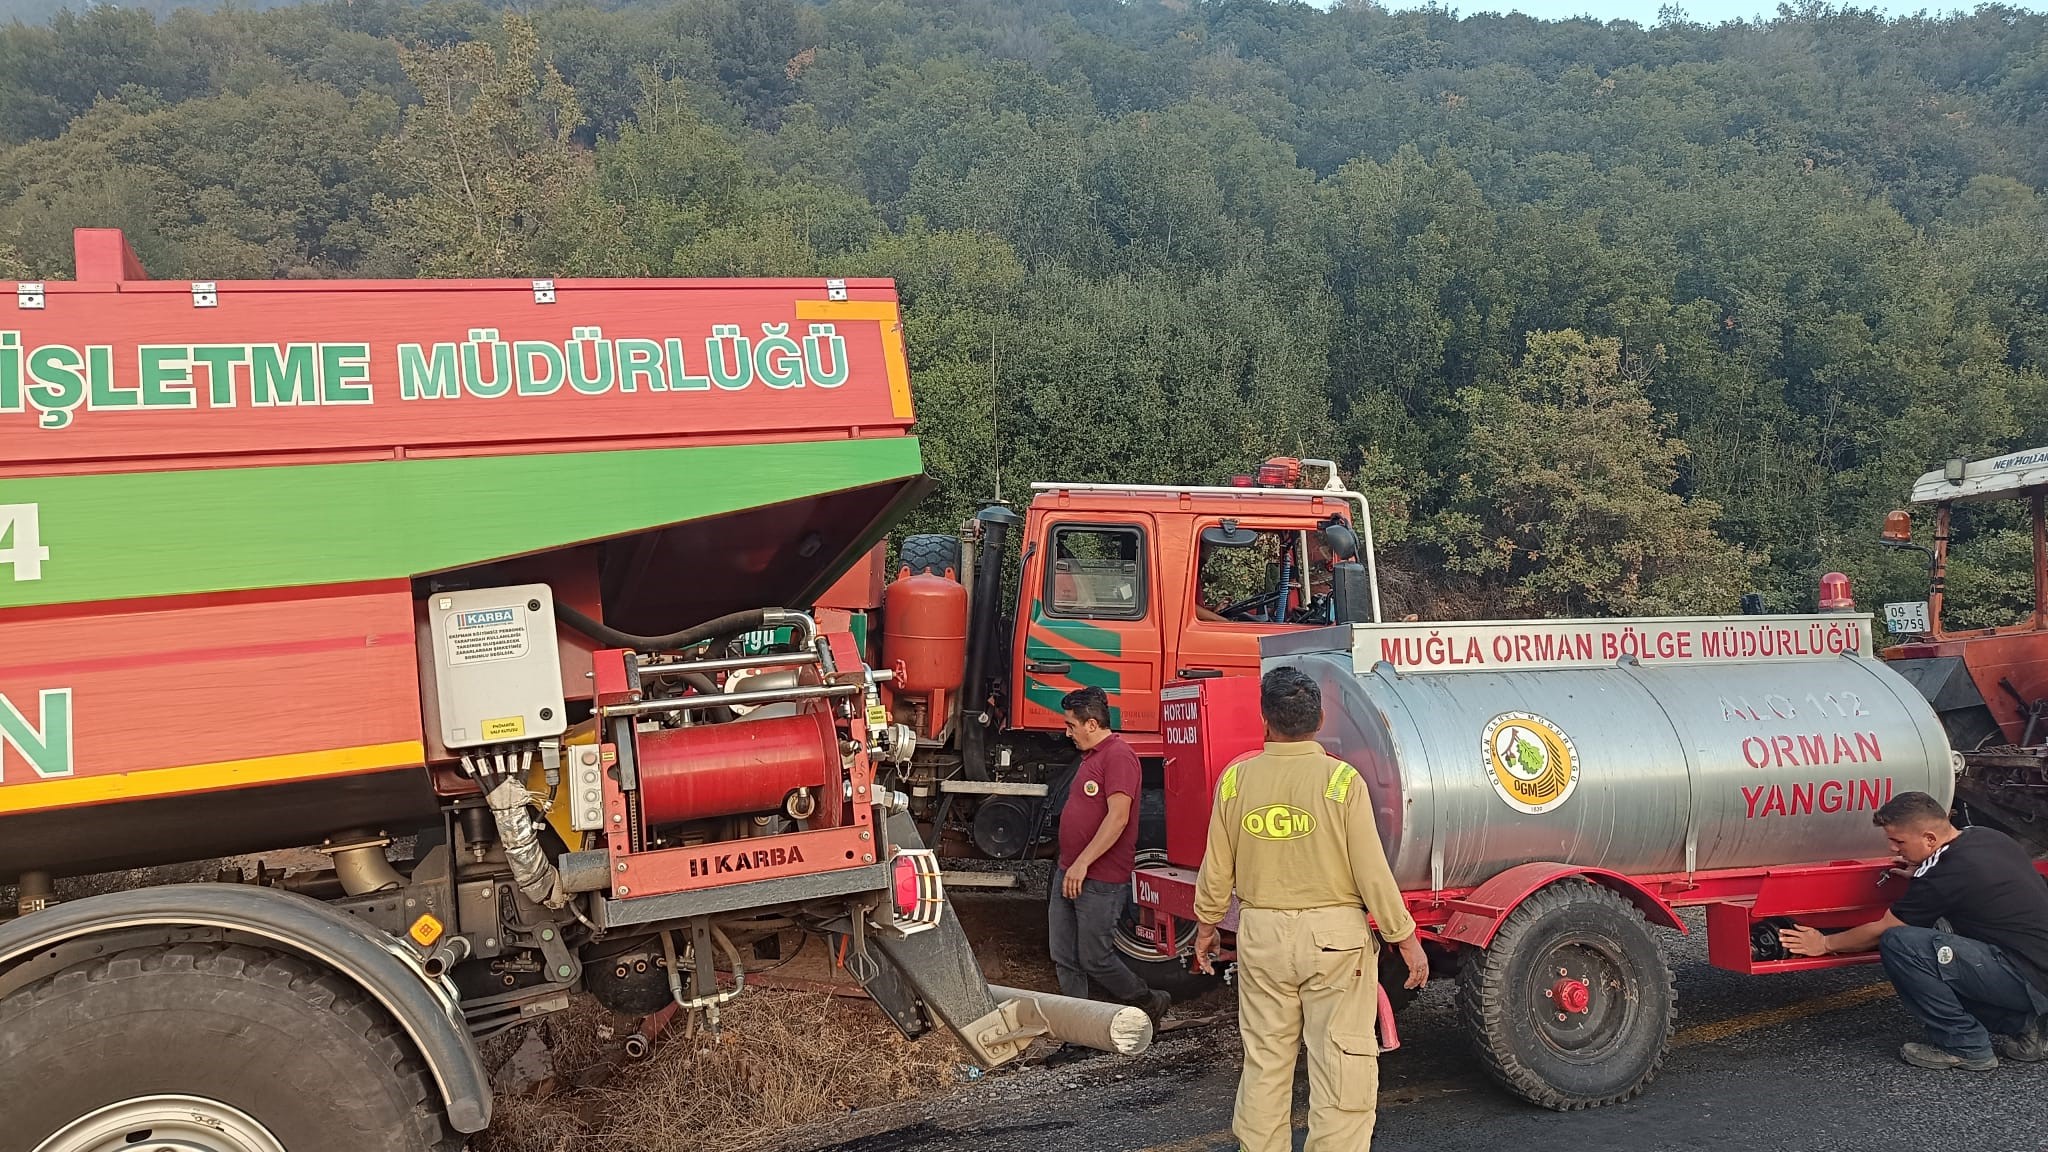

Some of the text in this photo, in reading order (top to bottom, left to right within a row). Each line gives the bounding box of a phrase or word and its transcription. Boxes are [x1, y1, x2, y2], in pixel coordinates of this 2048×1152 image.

[0, 323, 849, 429] İŞLETME MÜDÜRLÜĞÜ
[1993, 458, 2013, 470] NEW
[467, 611, 513, 624] KARBA
[1896, 618, 1924, 630] 5759
[1381, 622, 1860, 666] MUĞLA ORMAN BÖLGE MÜDÜRLÜĞÜ
[1163, 702, 1198, 721] HORTUM
[1166, 726, 1197, 744] DOLABI
[1742, 731, 1883, 768] ORMAN
[1484, 739, 1500, 786] ORMAN
[1514, 779, 1538, 798] OGM
[1741, 777, 1892, 819] YANGINI
[1246, 806, 1310, 838] OGM
[715, 845, 805, 874] KARBA
